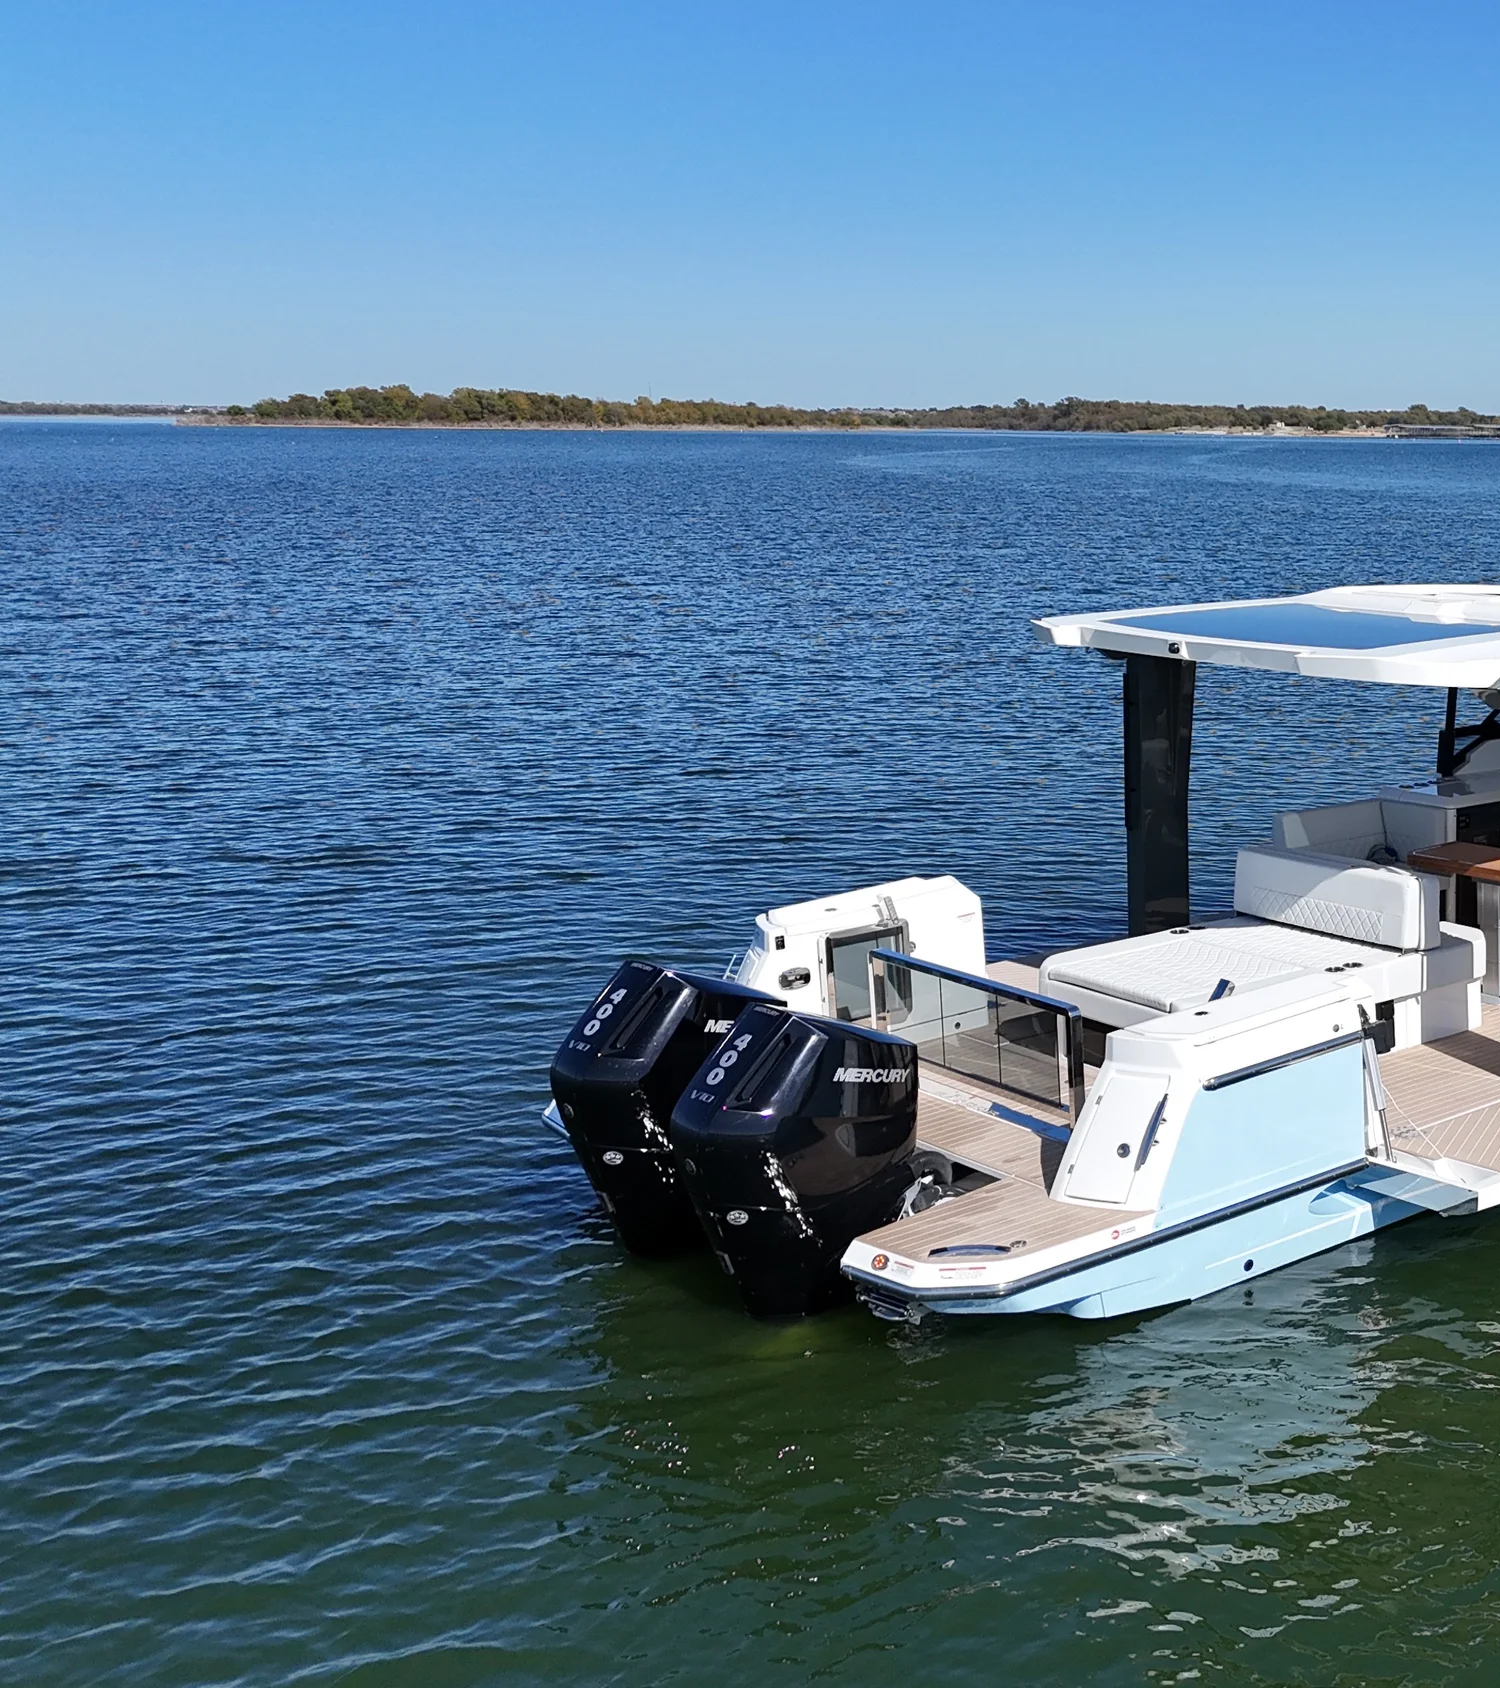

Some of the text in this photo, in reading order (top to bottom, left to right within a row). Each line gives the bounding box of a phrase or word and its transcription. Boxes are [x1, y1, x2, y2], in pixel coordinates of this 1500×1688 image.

[583, 988, 628, 1036] 400
[706, 1033, 753, 1085] 400
[832, 1067, 910, 1083] MERCURY
[690, 1089, 715, 1103] V10
